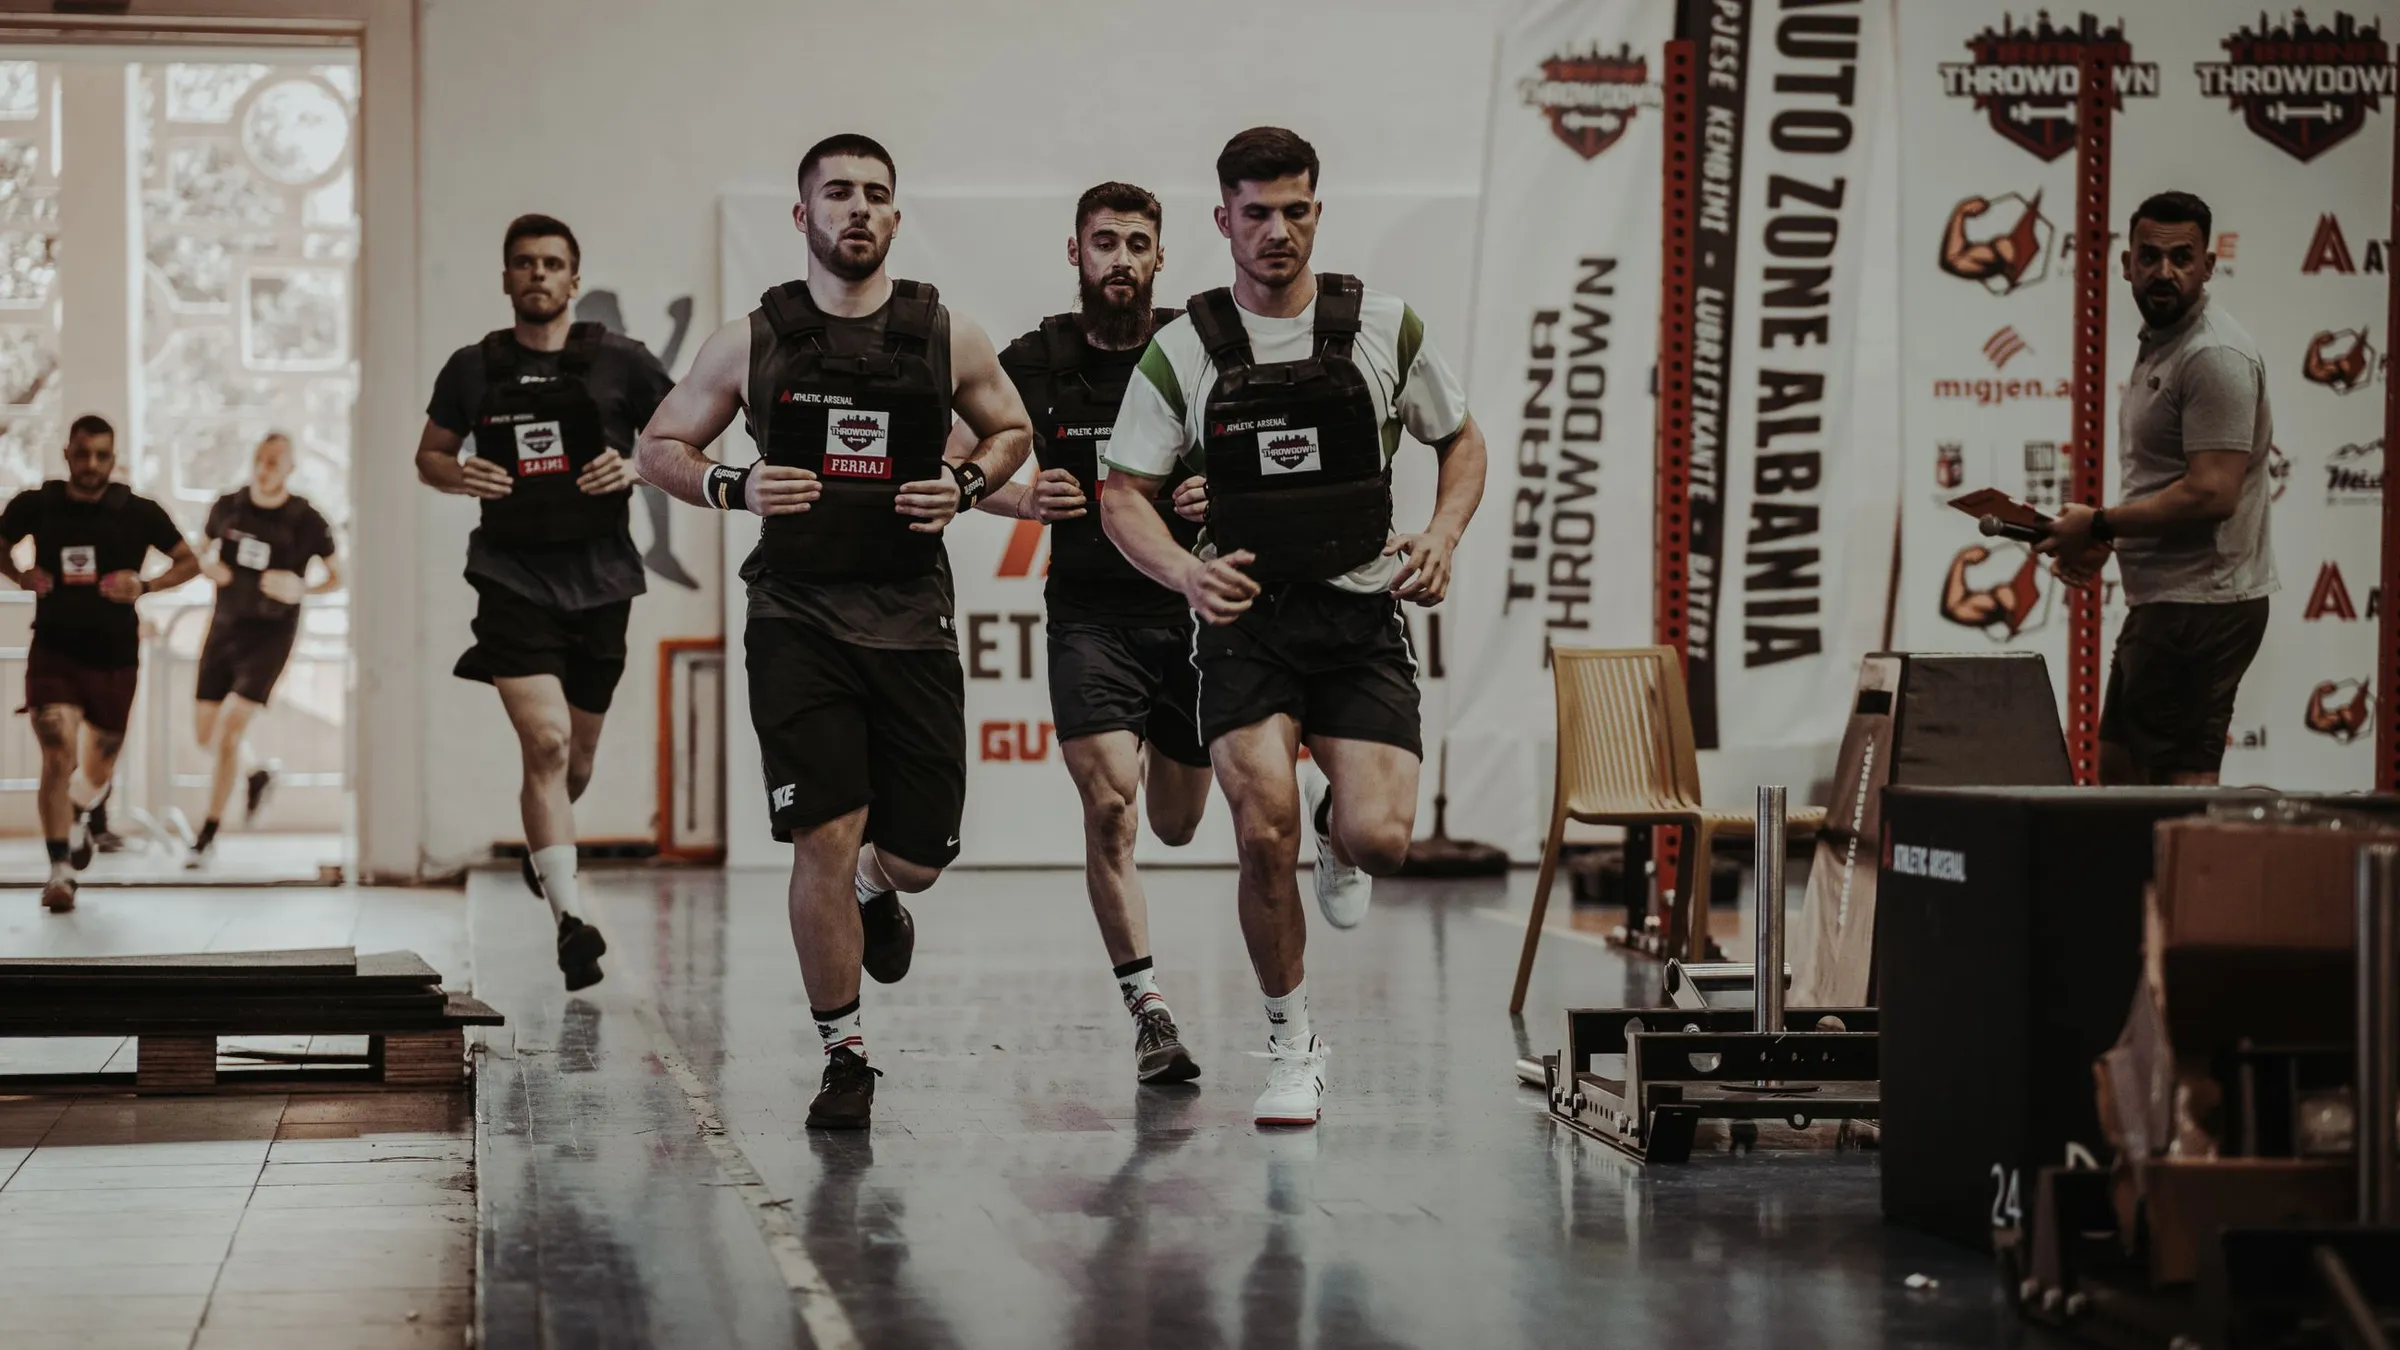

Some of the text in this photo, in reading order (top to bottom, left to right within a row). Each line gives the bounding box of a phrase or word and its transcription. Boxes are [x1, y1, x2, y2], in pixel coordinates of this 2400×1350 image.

[1942, 64, 2157, 96] THROWDWN
[1743, 0, 1862, 670] UTO ZONE ALBANIA
[792, 392, 854, 406] ATHLETIC ARSENAL
[1933, 377, 2073, 405] migjen.a
[831, 426, 886, 439] THROWDOWN
[1066, 427, 1092, 437] ATHLETIC
[1226, 417, 1287, 433] ATHLETIC ARSENAL
[1262, 443, 1317, 458] THROWDOWN
[830, 457, 886, 475] FERRAJ
[1852, 741, 1876, 833] ARSENAL
[1990, 1162, 2023, 1228] 24
